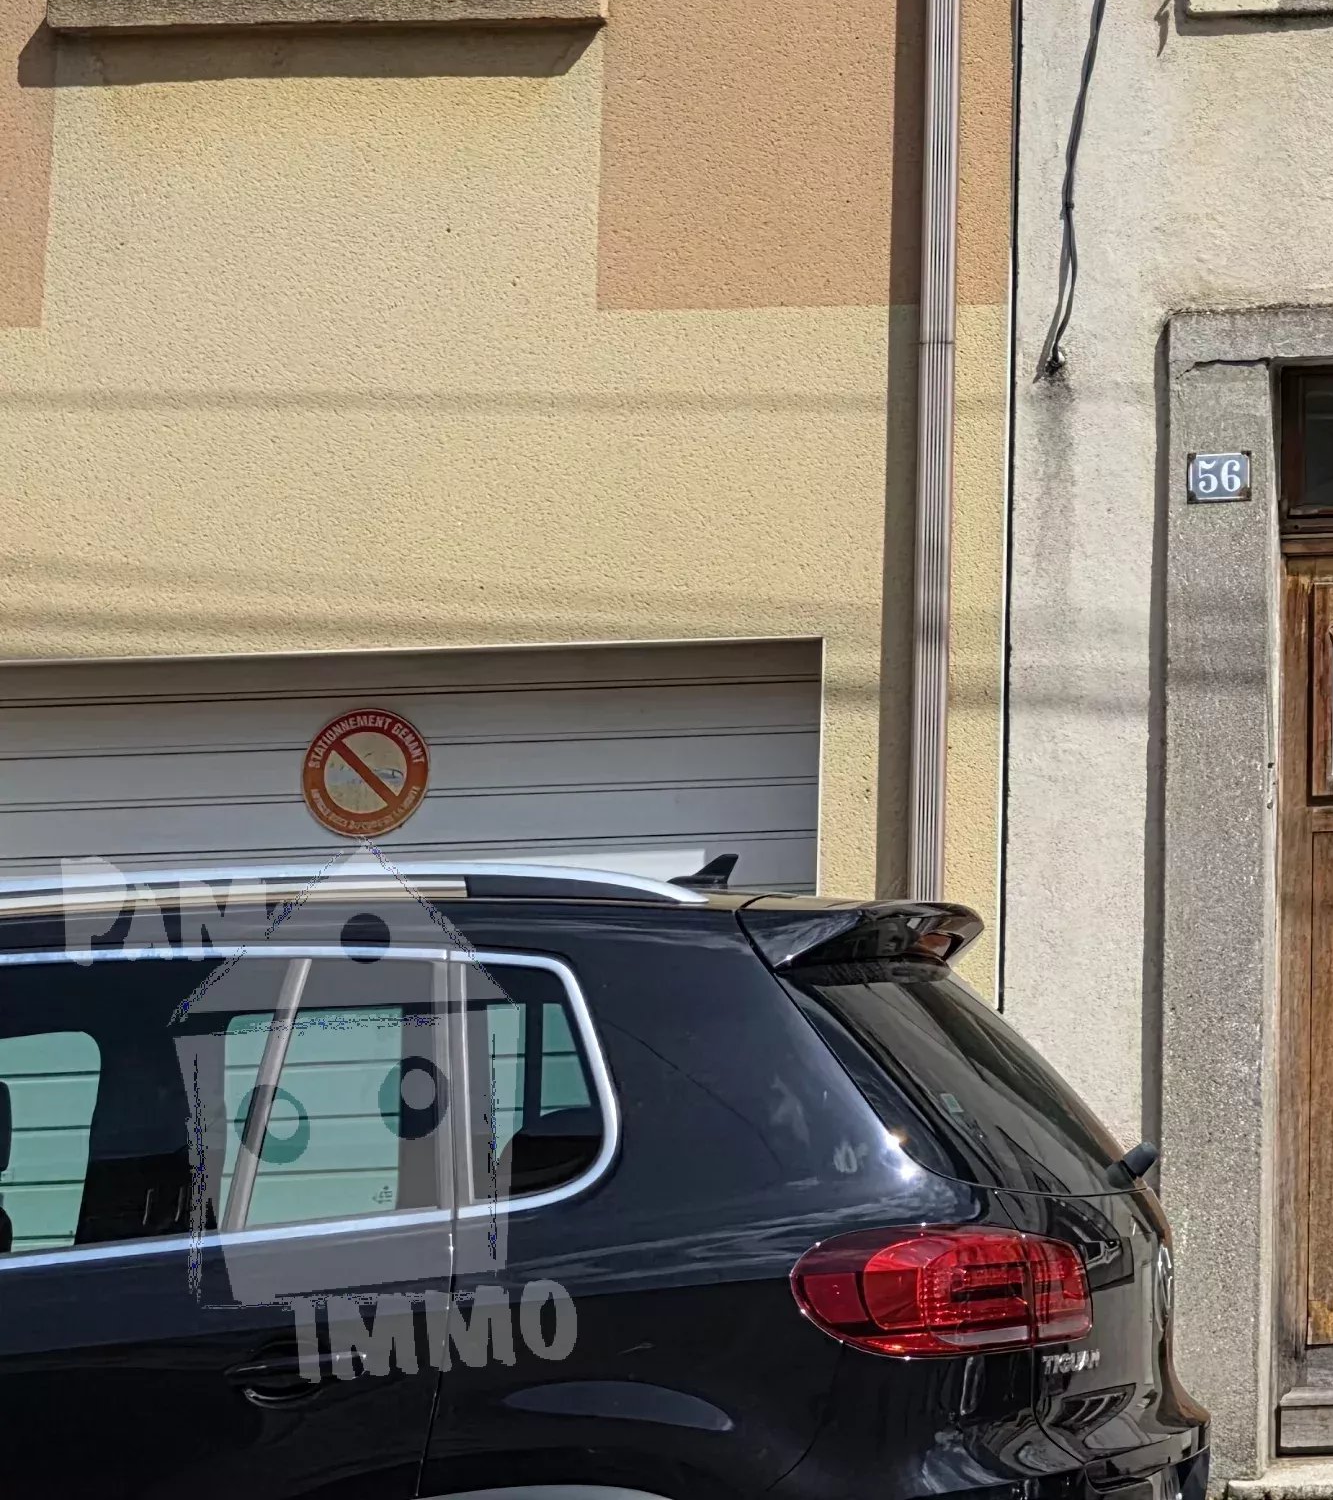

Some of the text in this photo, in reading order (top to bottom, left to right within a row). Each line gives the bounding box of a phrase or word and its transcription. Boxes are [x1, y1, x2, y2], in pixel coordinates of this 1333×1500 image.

[1198, 459, 1241, 493] 56
[308, 714, 392, 769] STATIONNEMENT
[1041, 1349, 1101, 1375] TIGUAN
